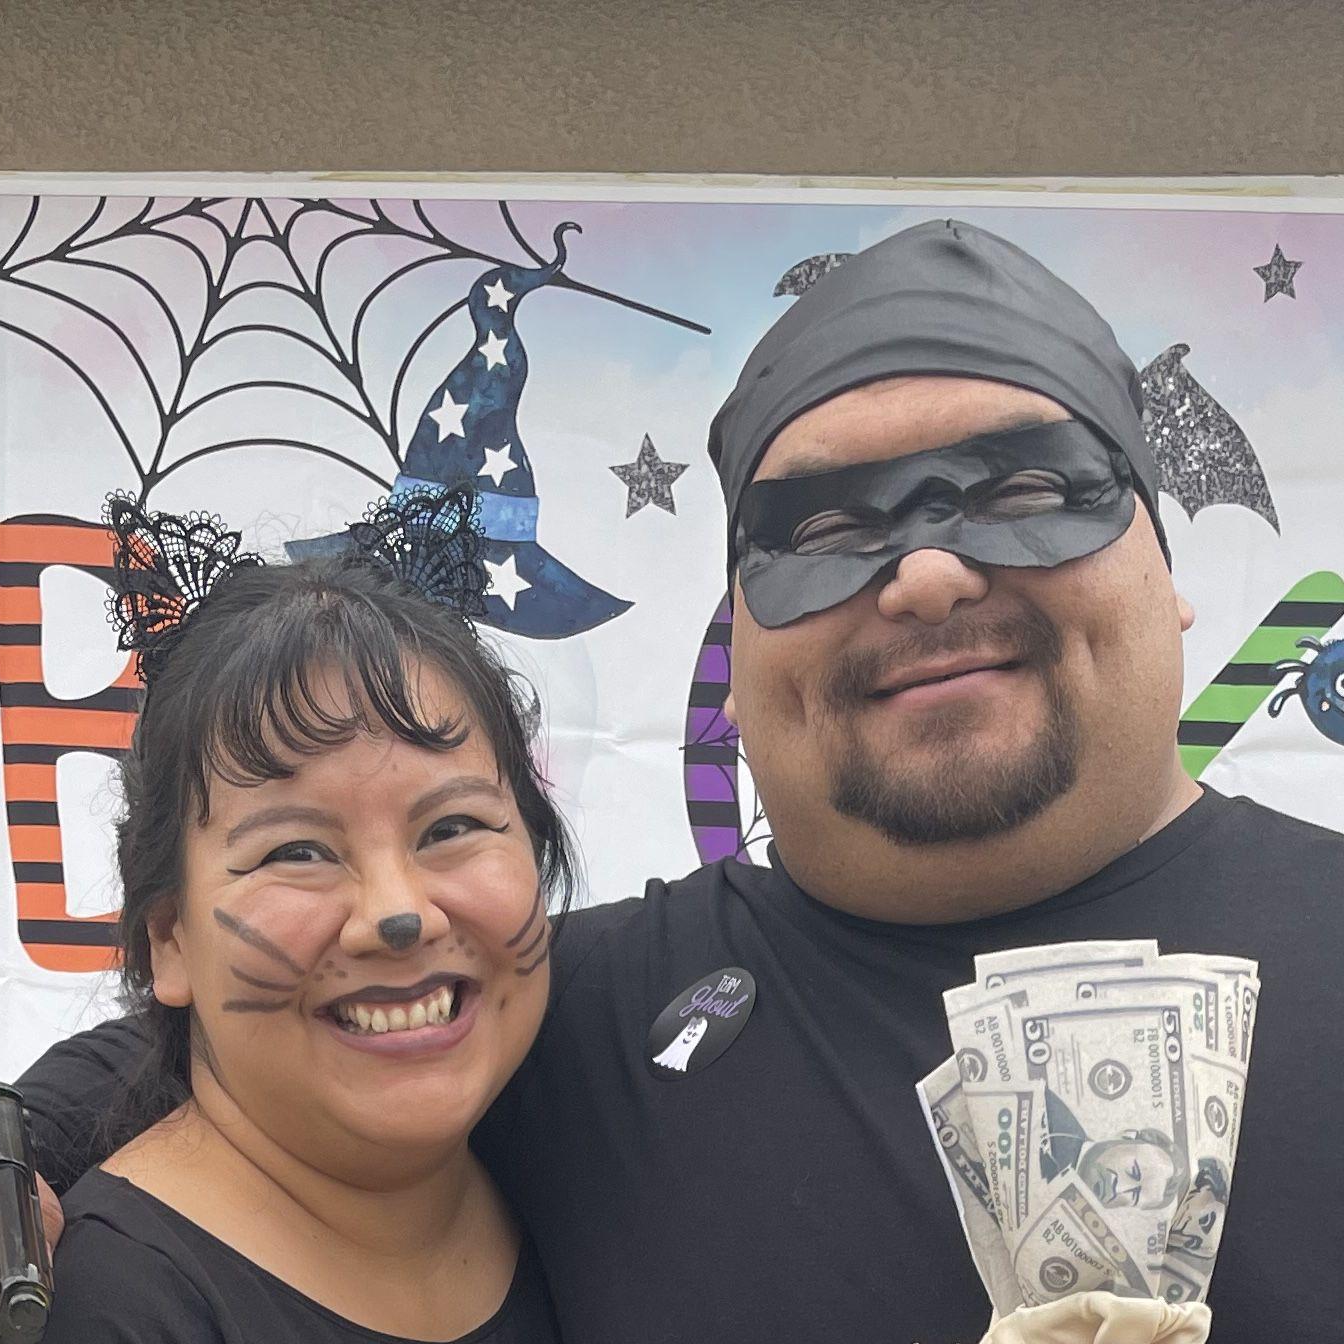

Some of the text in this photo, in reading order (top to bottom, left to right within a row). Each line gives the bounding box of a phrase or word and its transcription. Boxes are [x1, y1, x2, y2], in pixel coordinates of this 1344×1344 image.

[974, 1019, 986, 1035] B2
[986, 1016, 1000, 1032] AB
[1162, 1009, 1181, 1063] 50
[1024, 1019, 1052, 1065] 50
[997, 1107, 1012, 1170] 100
[1042, 1227, 1056, 1244] B2
[1050, 1219, 1065, 1235] AB
[1068, 1190, 1128, 1263] 100
